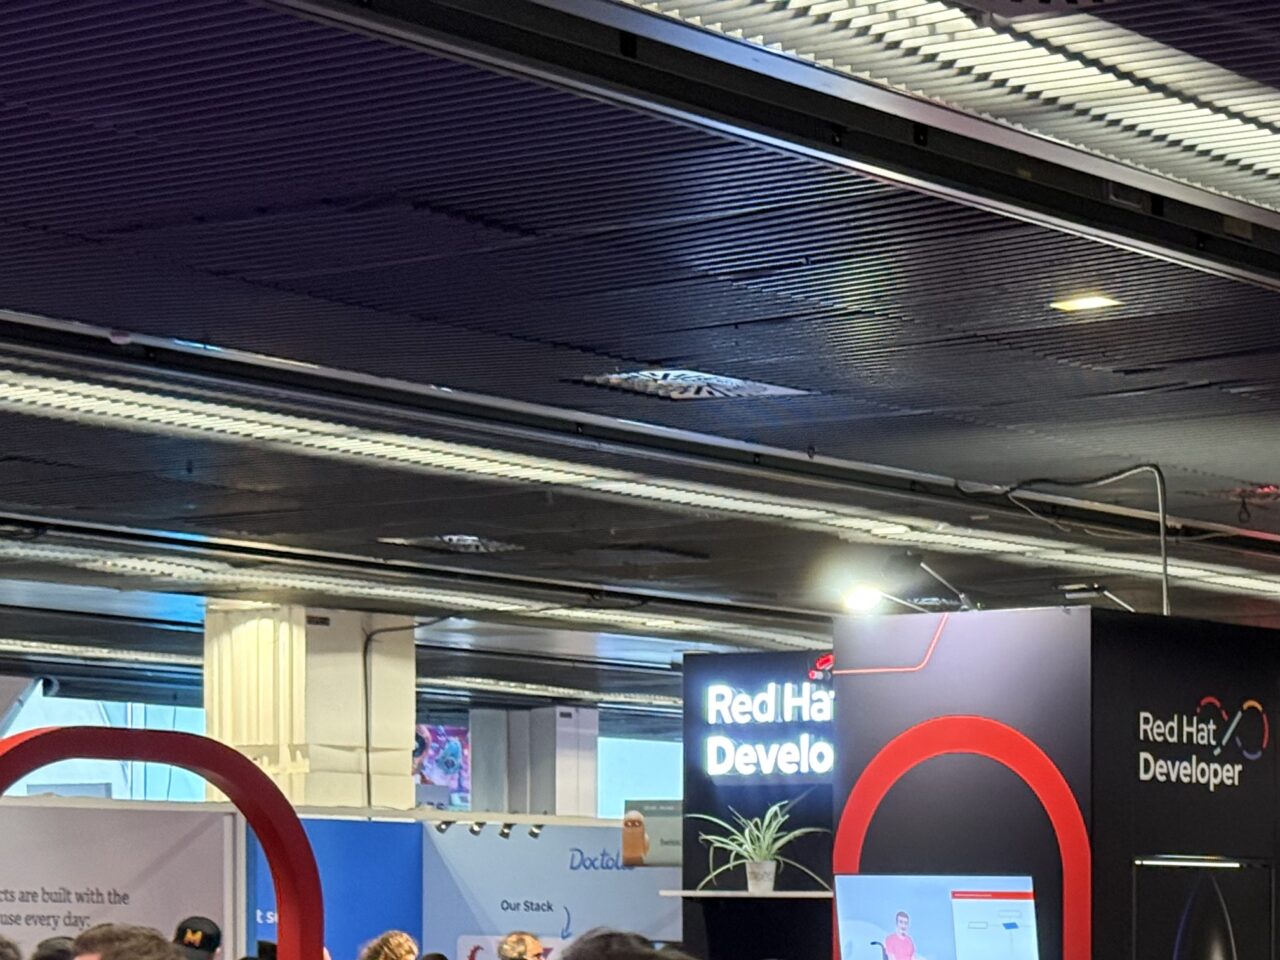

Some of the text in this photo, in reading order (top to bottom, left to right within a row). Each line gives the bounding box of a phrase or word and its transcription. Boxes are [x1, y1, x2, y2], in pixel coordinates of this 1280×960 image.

[707, 682, 836, 725] Red Ha
[1139, 711, 1217, 746] Red Hat
[706, 733, 835, 776] Develo
[1139, 751, 1243, 792] Developer
[18, 889, 38, 903] are
[41, 887, 72, 904] built
[74, 887, 105, 905] with
[107, 888, 130, 905] the
[500, 900, 554, 913] Our Stack
[25, 913, 60, 931] every
